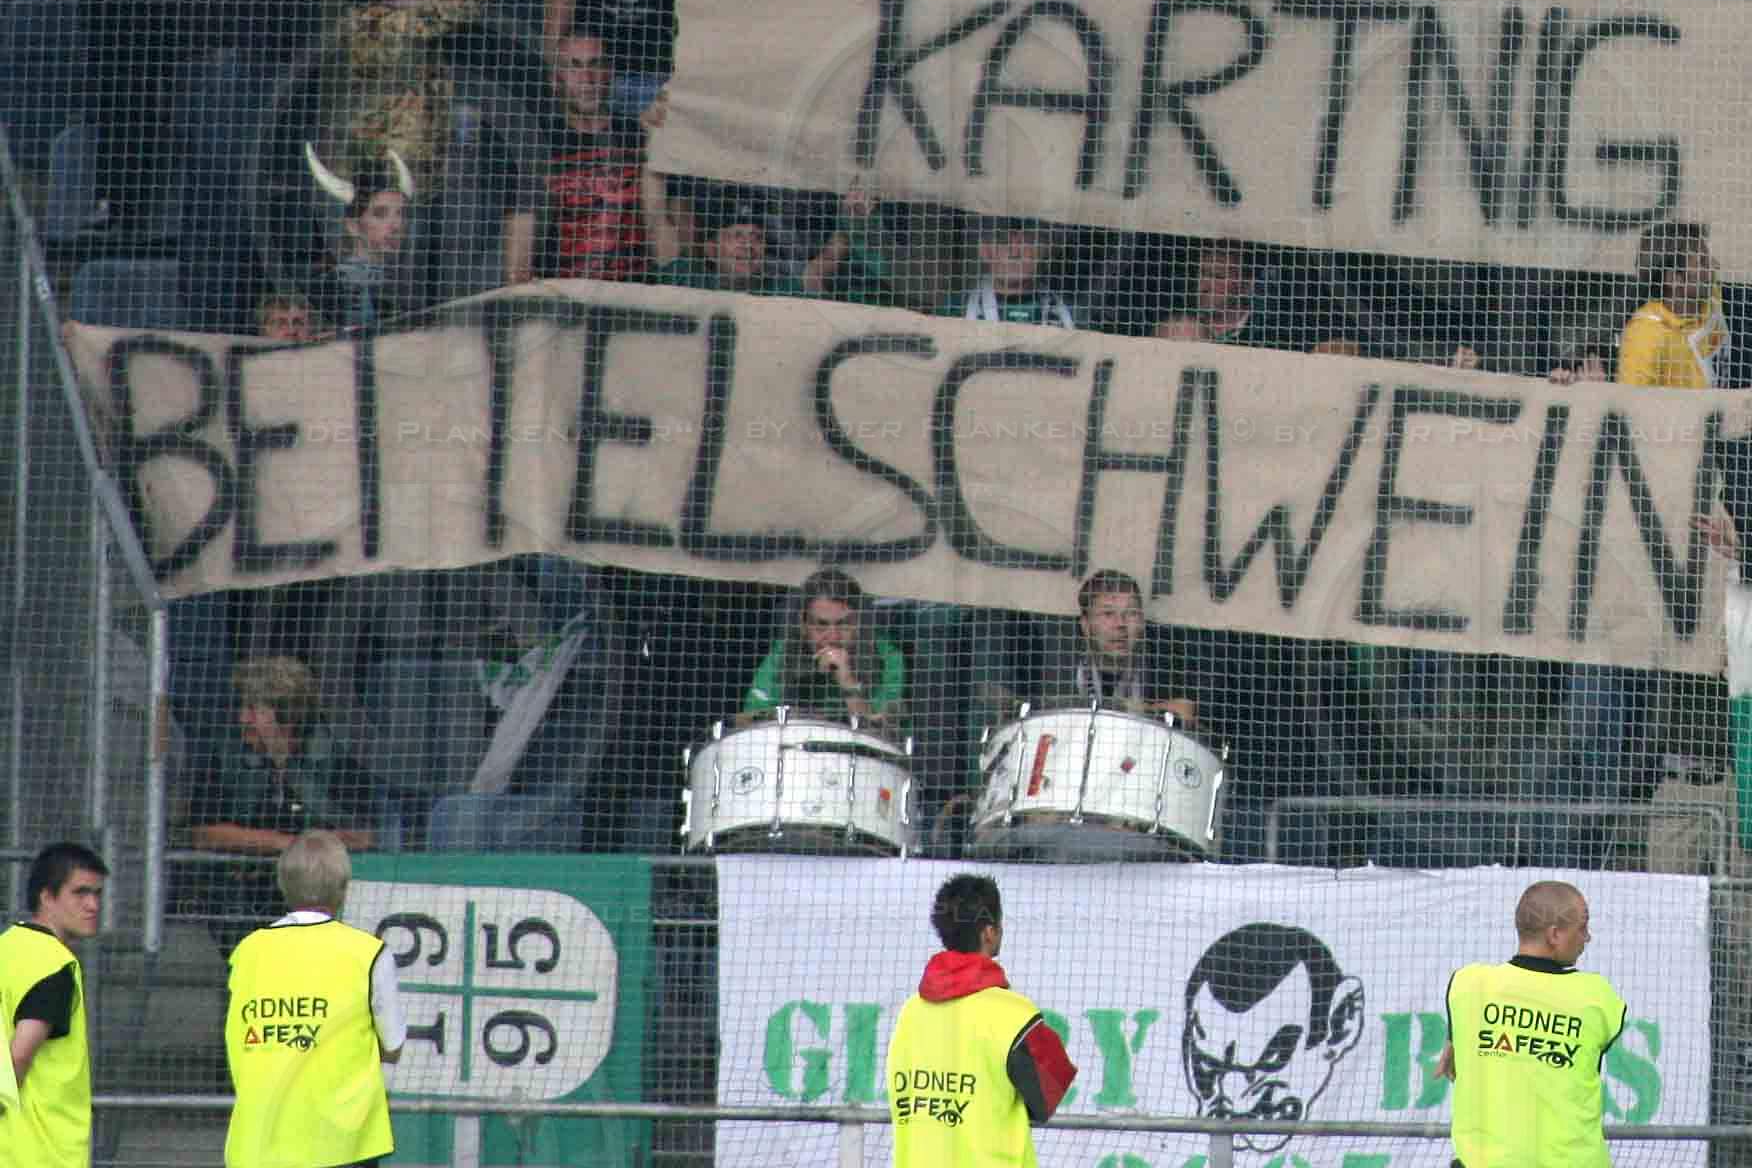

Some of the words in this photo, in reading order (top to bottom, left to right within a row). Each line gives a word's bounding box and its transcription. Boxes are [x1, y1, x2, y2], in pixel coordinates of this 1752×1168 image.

[1484, 1003, 1582, 1038] ORDNER
[1478, 1030, 1582, 1058] SAFETY
[894, 1069, 976, 1095] ODNER
[896, 1096, 970, 1118] SFETY
